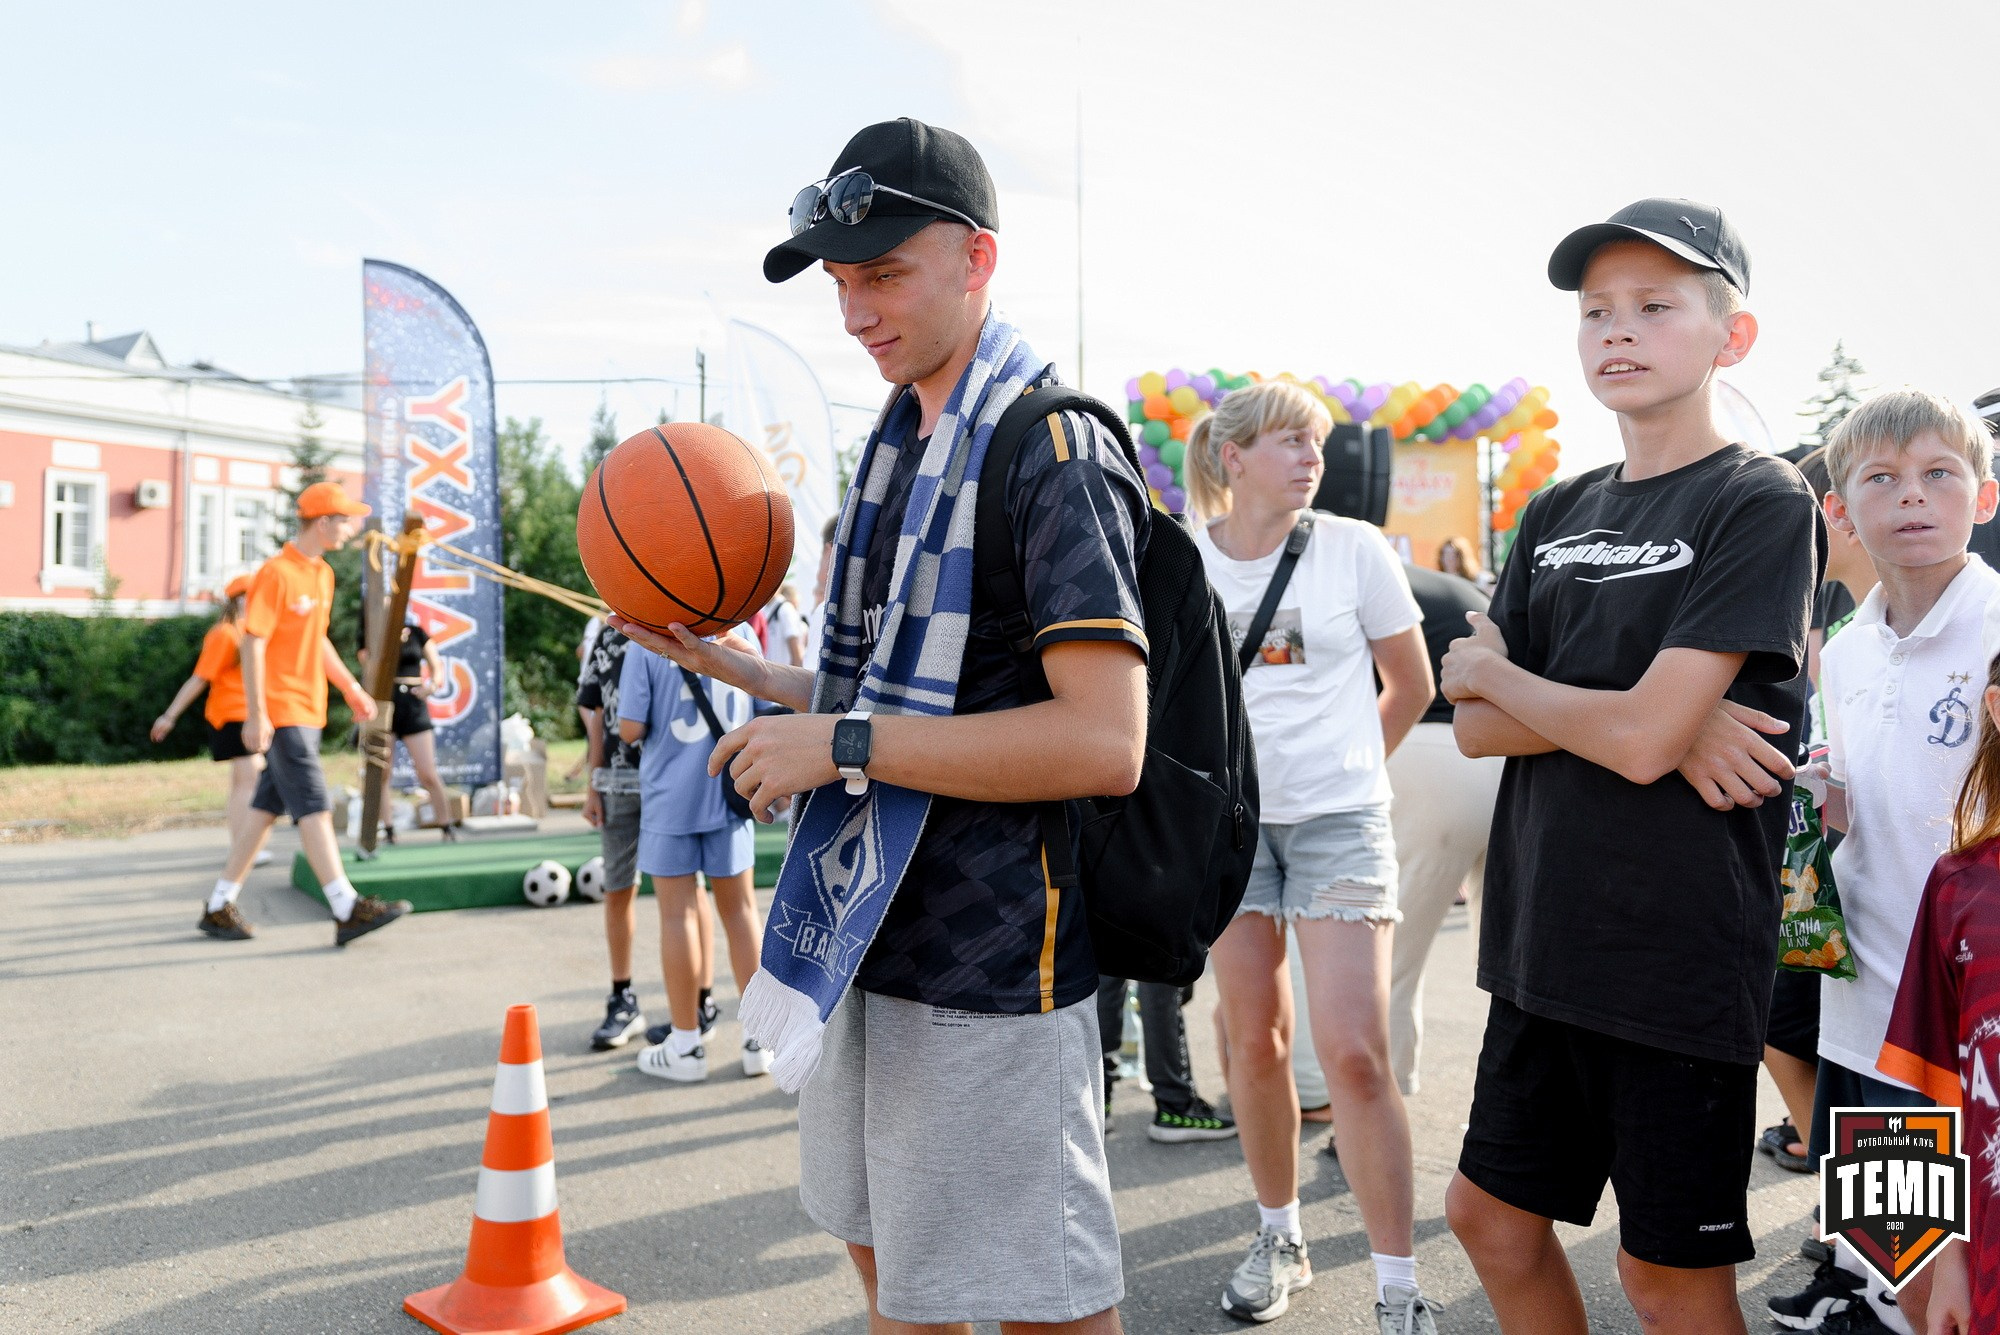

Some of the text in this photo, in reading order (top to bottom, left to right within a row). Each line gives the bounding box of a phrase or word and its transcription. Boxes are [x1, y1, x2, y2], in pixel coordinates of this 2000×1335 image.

[1538, 541, 1668, 570] syndicate
[1797, 936, 1810, 948] ЛУК
[1698, 1221, 1736, 1232] DEMIX
